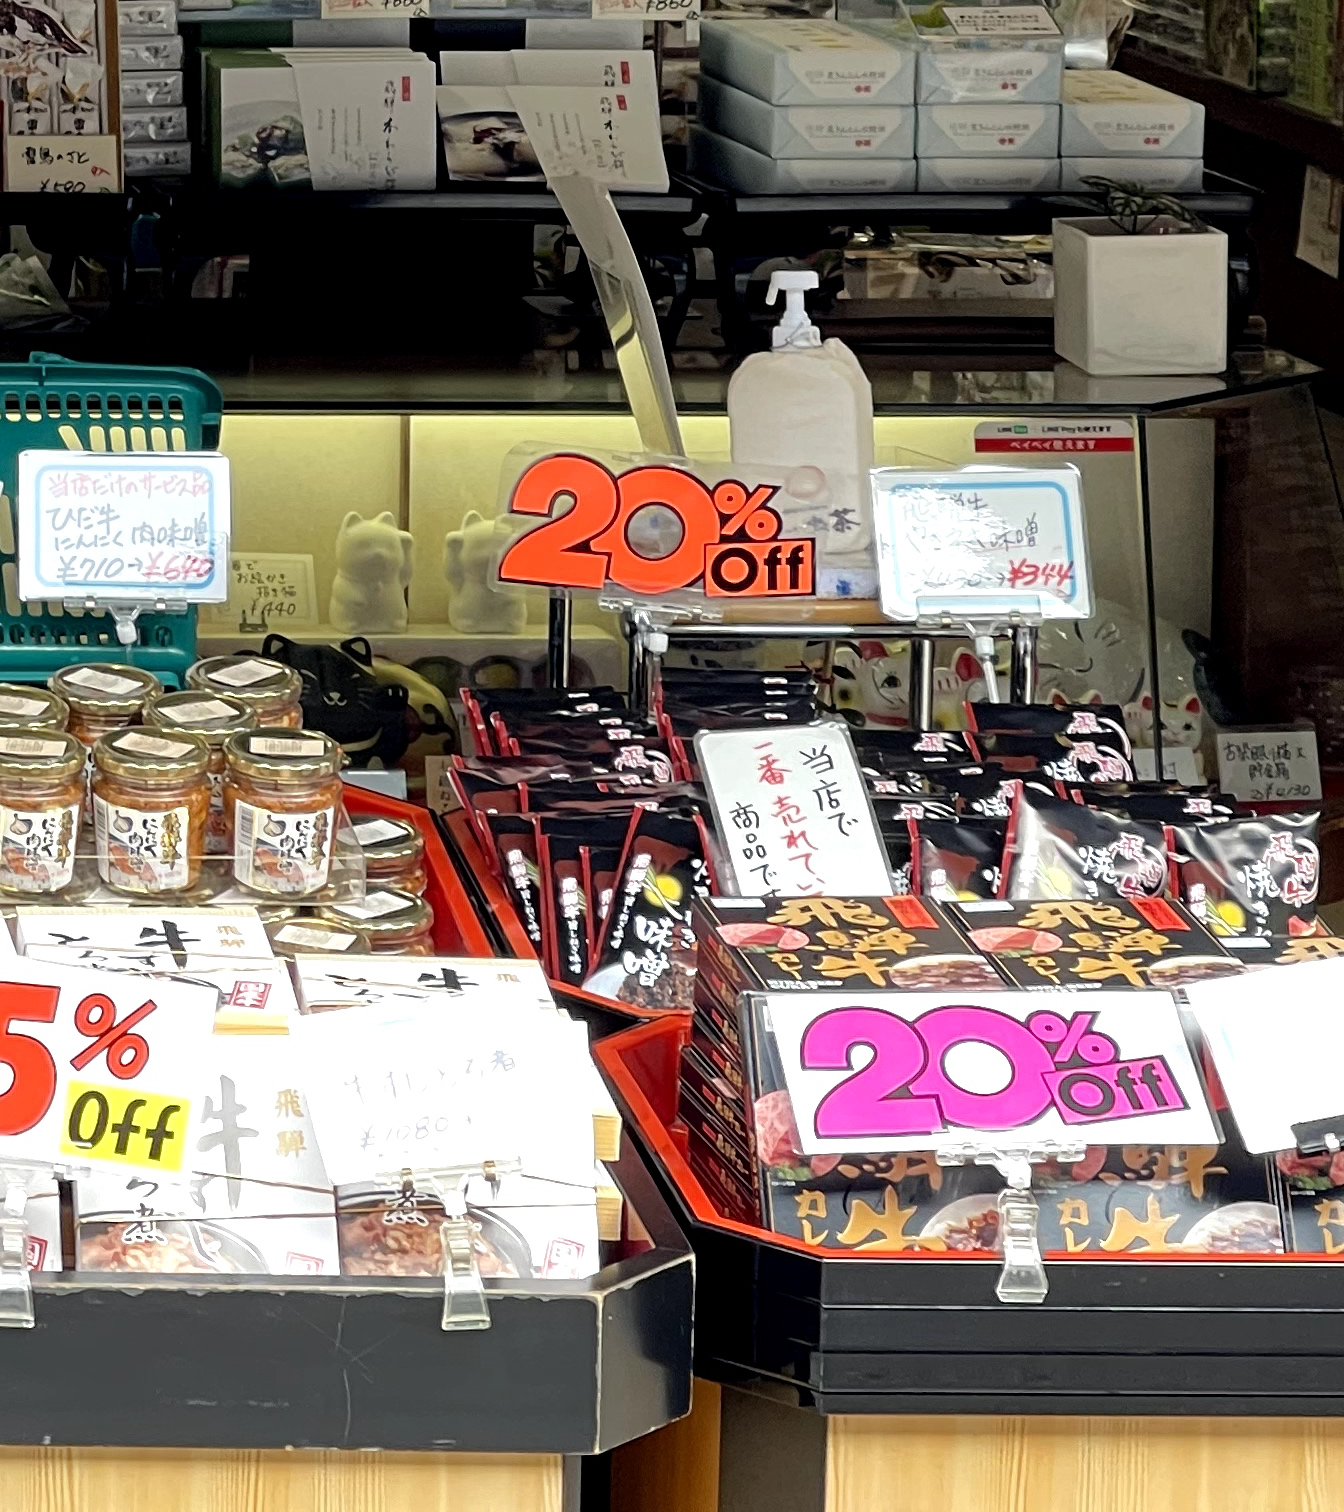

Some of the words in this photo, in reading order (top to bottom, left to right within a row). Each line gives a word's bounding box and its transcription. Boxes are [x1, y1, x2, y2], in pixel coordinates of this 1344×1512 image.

[48, 471, 212, 498] 当店だけのサービス品
[46, 503, 120, 536] ひだ牛
[798, 744, 859, 839] 当店で
[1057, 1059, 1175, 1120] Off
[68, 1088, 183, 1162] Off
